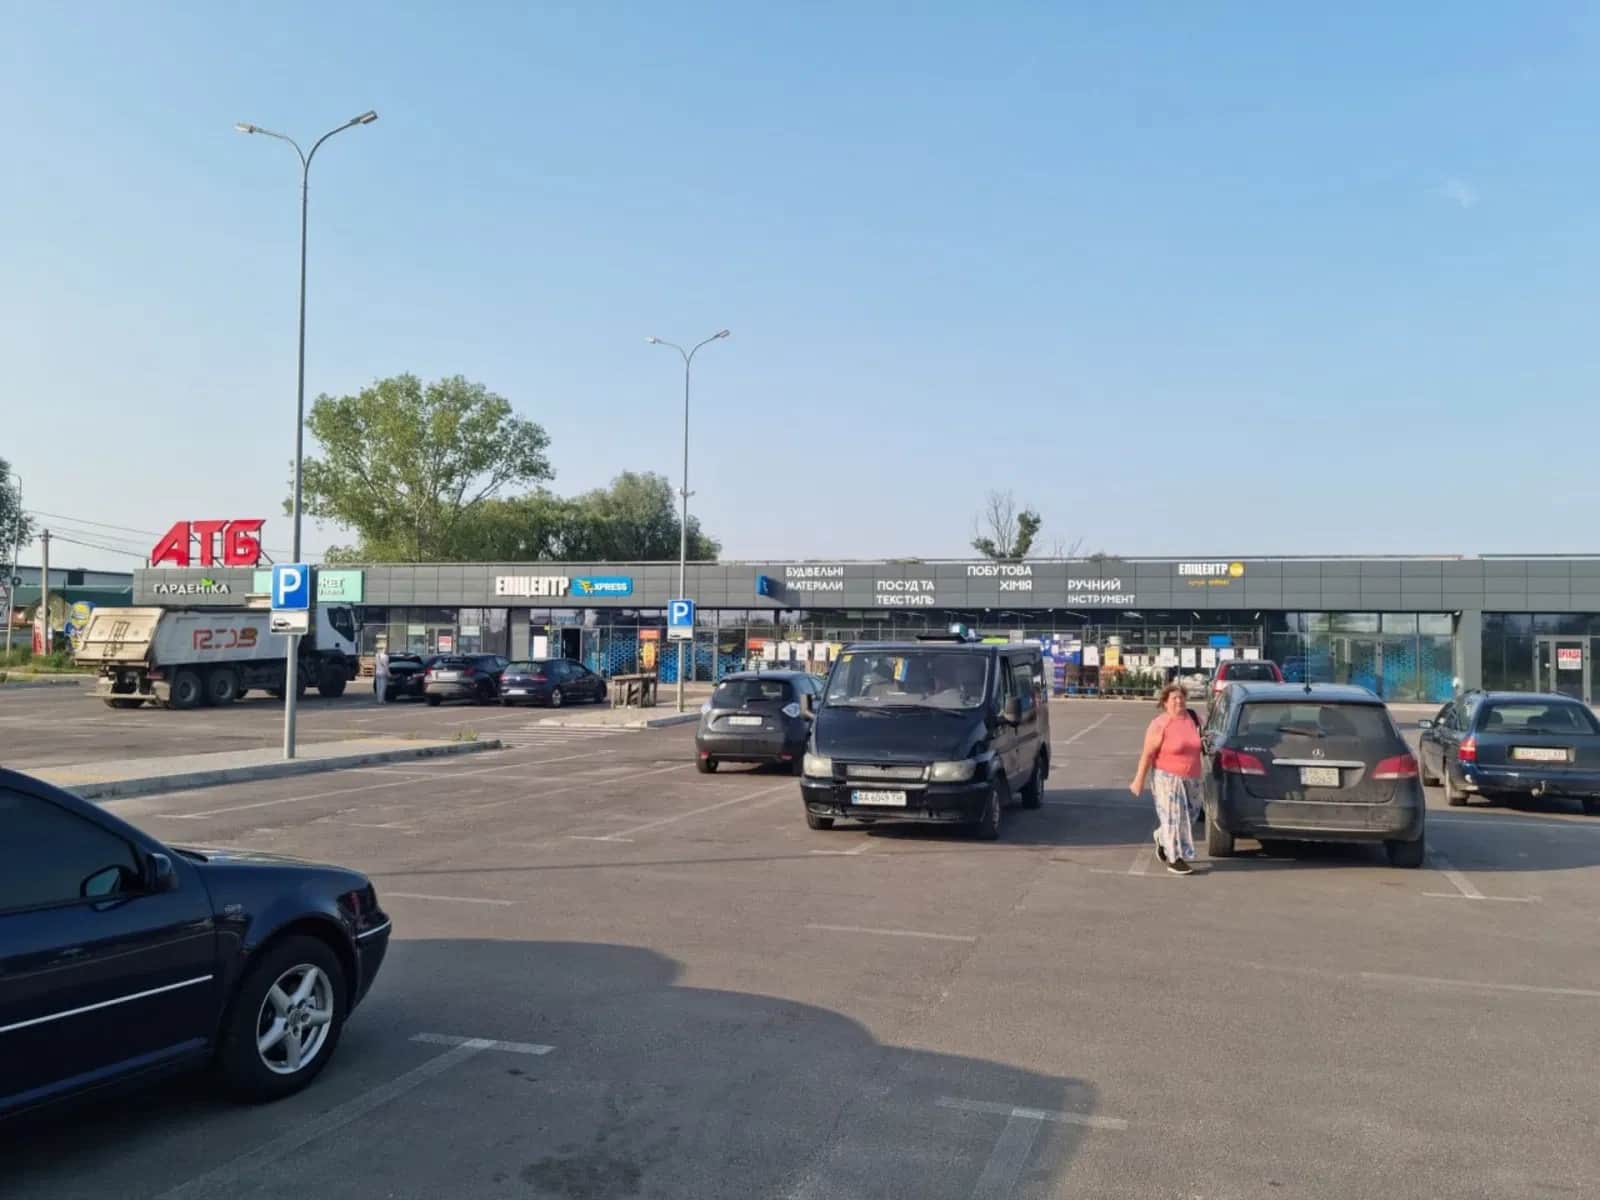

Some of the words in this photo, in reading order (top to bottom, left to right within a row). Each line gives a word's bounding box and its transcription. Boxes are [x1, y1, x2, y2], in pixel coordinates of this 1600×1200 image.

[152, 519, 265, 567] АТБ
[786, 567, 844, 577] БУДІВЕЛЬНІ
[967, 565, 1033, 577] ПОБУТОВА
[153, 583, 229, 594] ГАРДЕНІКА
[279, 568, 301, 605] P
[786, 581, 844, 591] МАТЕРІАЛИ
[877, 580, 918, 592] ПОСУД
[920, 581, 935, 591] ТА
[999, 580, 1032, 591] ХІМІЯ
[1067, 578, 1121, 591] РУЧНИЙ
[877, 595, 935, 606] ТЕКСТИЛЬ
[1067, 595, 1135, 605] ІНСТРУМЕНТ
